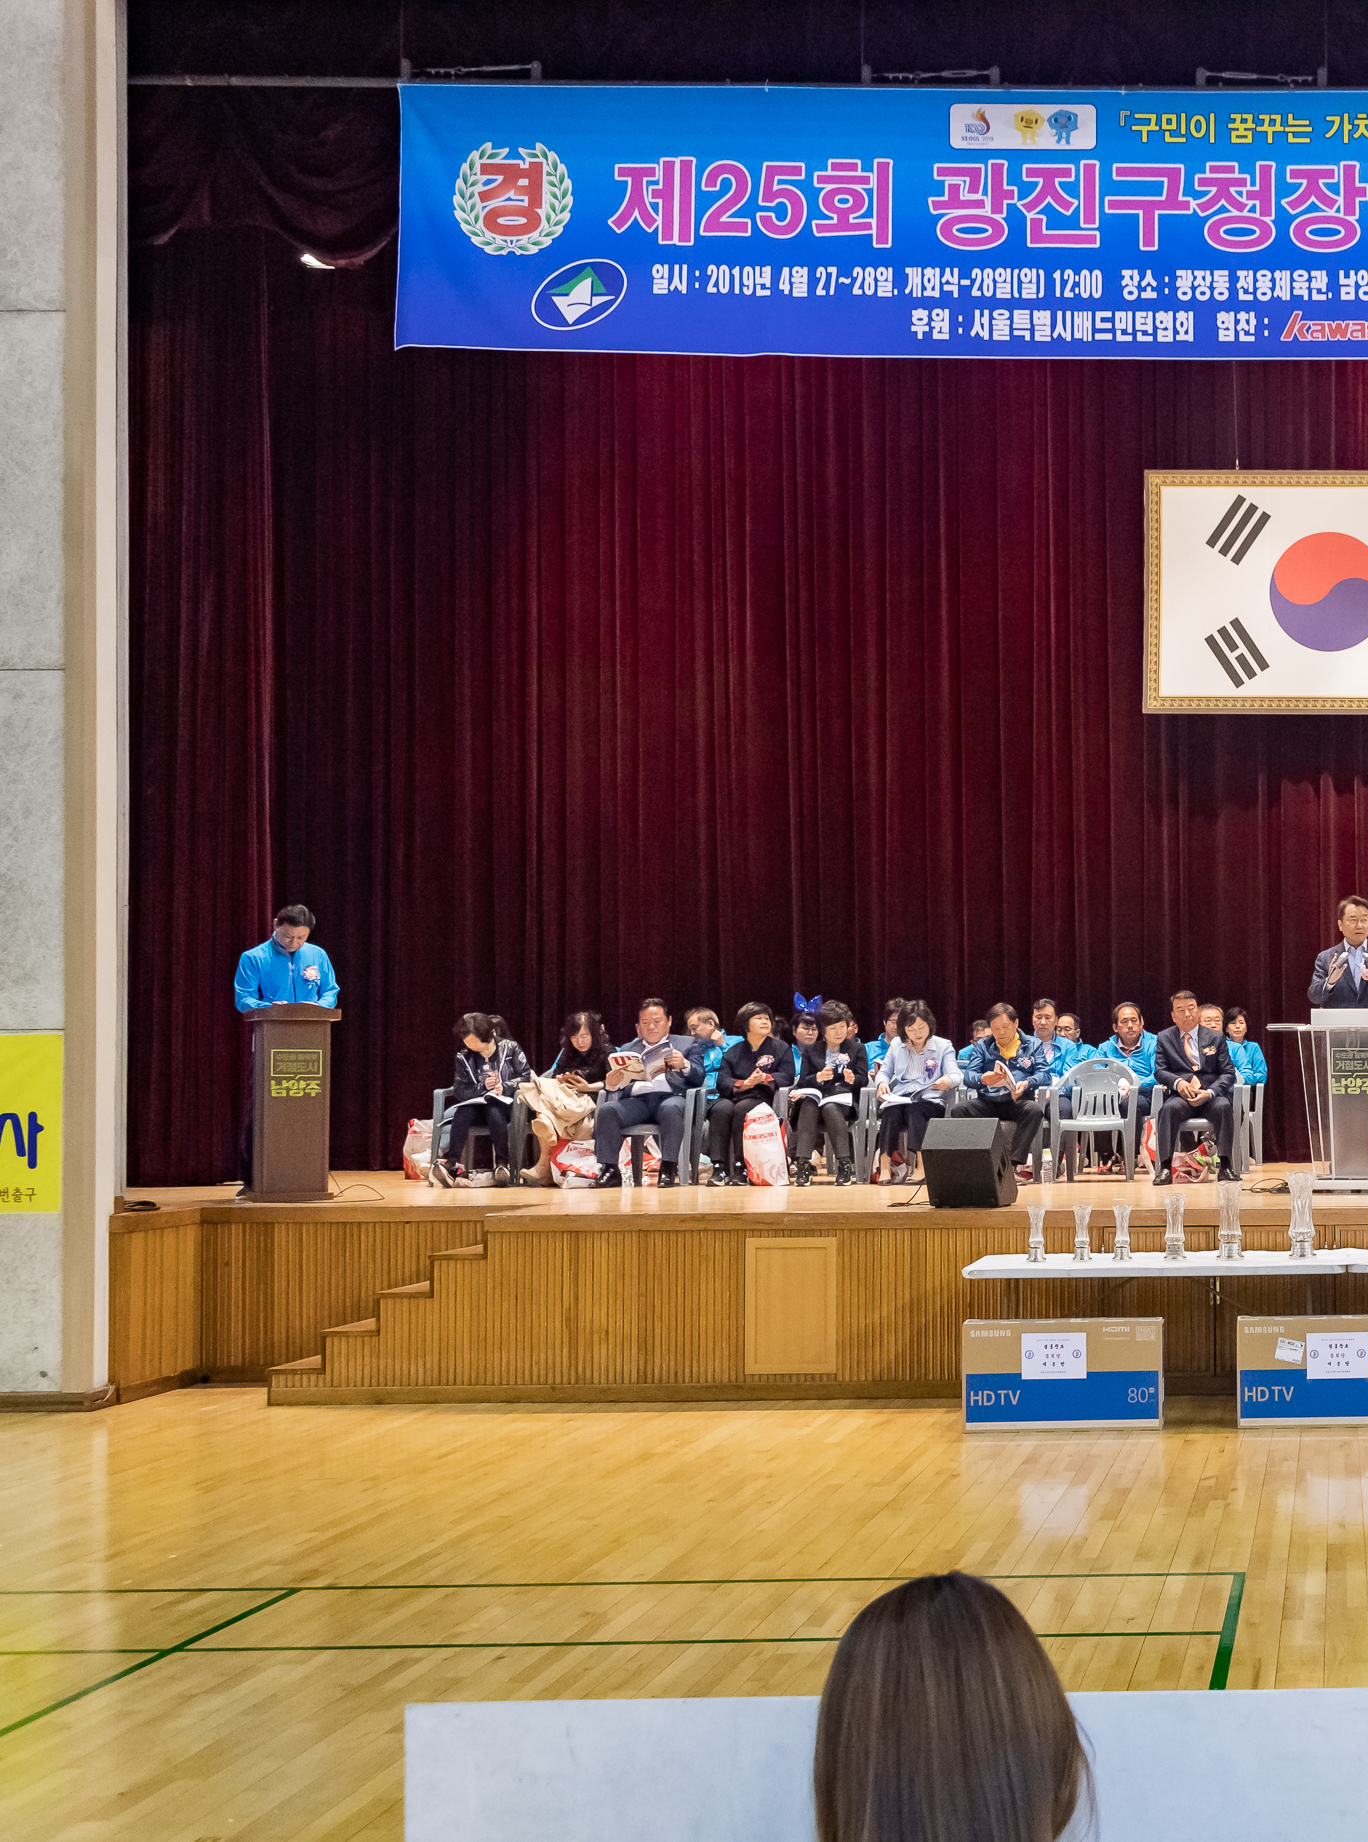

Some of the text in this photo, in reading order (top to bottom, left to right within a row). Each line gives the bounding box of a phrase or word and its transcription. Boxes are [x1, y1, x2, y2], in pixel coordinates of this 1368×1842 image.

[1227, 112, 1313, 144] 꿈꾸는
[476, 158, 545, 238] 경
[608, 157, 893, 248] 제25회
[706, 264, 772, 297] 2019년
[778, 266, 808, 298] 4월
[1052, 269, 1102, 299] 12:00
[1175, 269, 1230, 301] 광장동
[970, 308, 1194, 343] 서울특별시배드민턴협회
[271, 1080, 322, 1097] 남양주
[969, 1328, 1012, 1338] SAMSUNG
[1243, 1325, 1285, 1335] SAMSUNG
